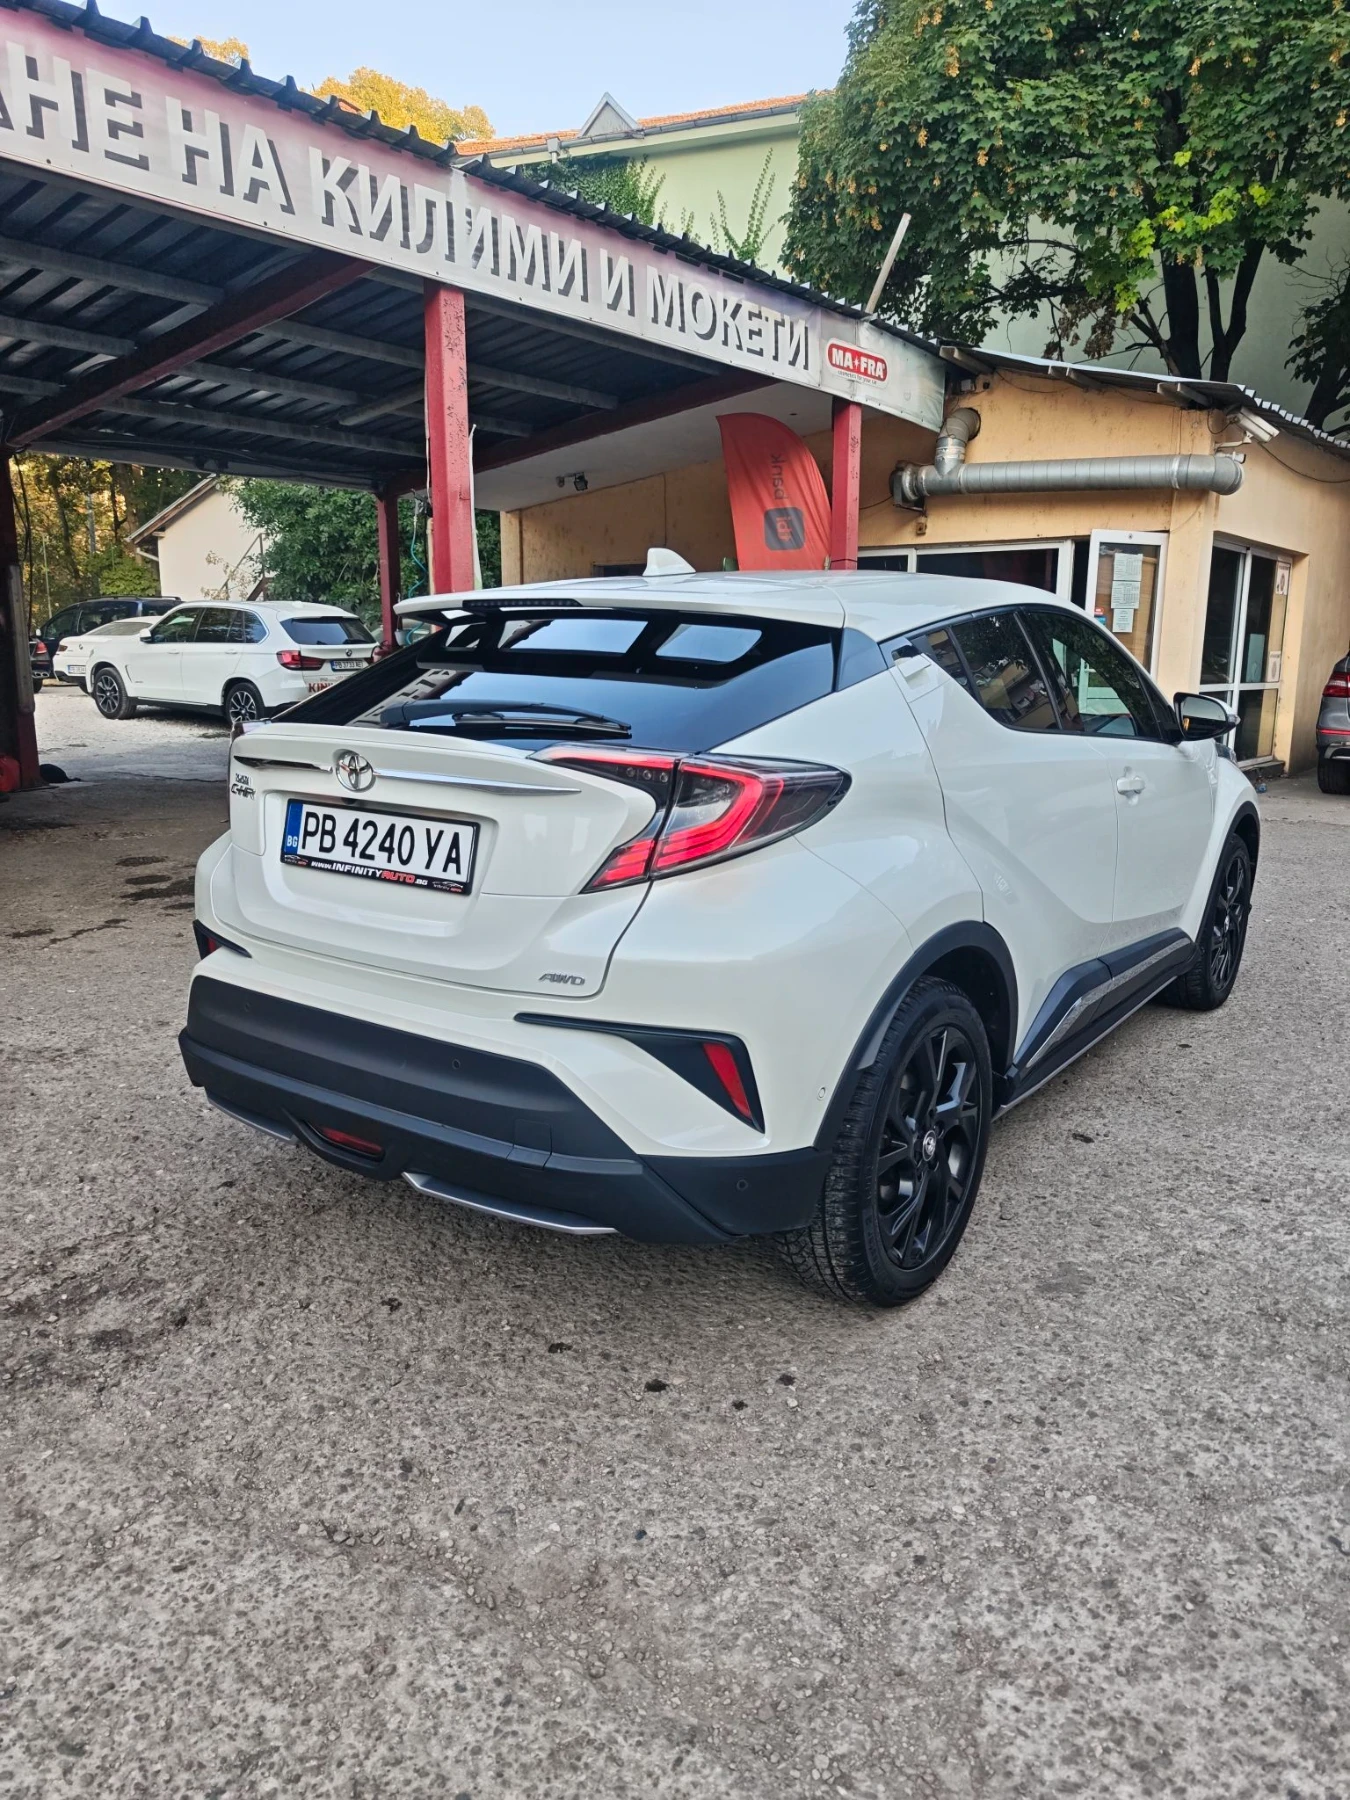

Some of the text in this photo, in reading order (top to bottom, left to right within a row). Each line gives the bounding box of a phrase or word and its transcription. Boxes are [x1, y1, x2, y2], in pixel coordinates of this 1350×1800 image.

[165, 96, 295, 216] НА
[308, 146, 589, 303] КИЛИМИ
[600, 247, 636, 318] И
[646, 265, 810, 371] МОКЕТИ
[287, 811, 462, 875] BG PB 4240 YA
[538, 973, 586, 986] AWD
